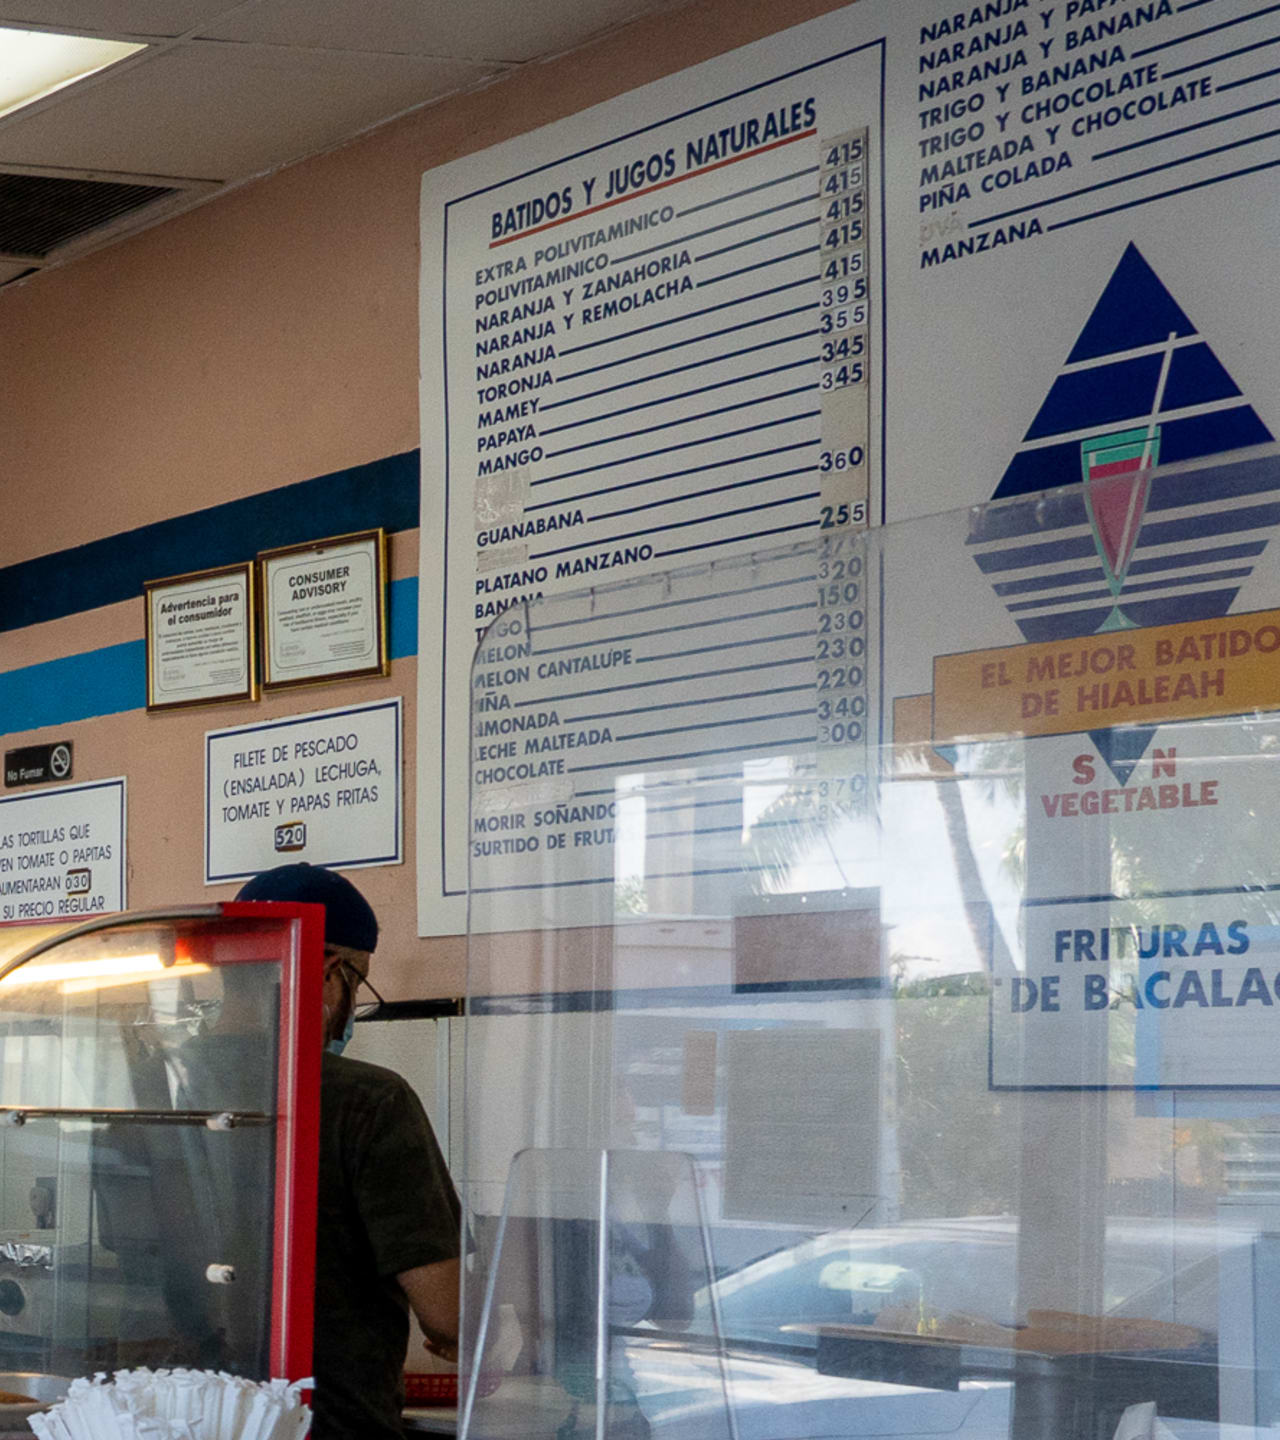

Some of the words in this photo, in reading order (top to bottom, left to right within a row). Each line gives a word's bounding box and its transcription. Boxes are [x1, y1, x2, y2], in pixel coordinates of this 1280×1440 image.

[918, 20, 1028, 74] NARANJA
[1039, 10, 1055, 30] Y
[918, 50, 1028, 103] NARANJA
[1039, 39, 1054, 60] Y
[1065, 0, 1174, 51] BANANA
[918, 121, 985, 158] TRIGO
[995, 111, 1010, 133] Y
[1021, 62, 1160, 125] CHOCOLATE
[919, 93, 985, 131] TRIGO
[995, 82, 1010, 103] Y
[1020, 45, 1126, 97] BANANA
[919, 135, 1035, 187] MALTEADA
[1045, 125, 1061, 146] Y
[1070, 76, 1214, 139] CHOCOLATE
[491, 187, 573, 240] BATIDOS
[582, 179, 598, 201] Y
[605, 147, 677, 200] JUGOS
[685, 97, 818, 170] NATURALES
[919, 181, 972, 214] PIÑA
[981, 150, 1074, 194] COLADA
[475, 254, 528, 286] EXTRA
[534, 205, 676, 268] POLIVITAMINICO
[825, 138, 864, 169] 415
[475, 252, 610, 310] POLIVITAMINICO
[824, 166, 863, 196] 415
[920, 217, 1043, 270] MANZANA
[475, 294, 556, 334] NARANJA
[562, 288, 575, 308] Y
[581, 249, 692, 301] ZANAHORIA
[825, 194, 864, 222] 415
[475, 320, 557, 359] NARANJA
[563, 312, 576, 332] Y
[581, 274, 694, 327] REMOLACHA
[825, 220, 864, 250] 415
[476, 344, 557, 382] NARANJA
[824, 252, 863, 283] 415
[477, 370, 554, 406] TORONJA
[822, 279, 867, 308] 395
[477, 397, 540, 430] MAMEY
[820, 306, 866, 334] 355
[477, 423, 537, 454] PAPAYA
[821, 334, 865, 363] 345
[478, 446, 544, 477] MANGO
[821, 363, 864, 391] 345
[476, 509, 585, 548] GUANABANA
[819, 446, 864, 473] 360
[475, 567, 548, 595] PLATANO
[555, 543, 654, 581] MANZANO
[819, 503, 865, 530] 255
[819, 556, 862, 581] 320
[288, 565, 350, 588] CONSUMER
[291, 580, 348, 602] ADVISORY
[817, 582, 859, 607] 150
[160, 597, 217, 615] Advertencia
[218, 592, 240, 606] para
[167, 613, 177, 627] el
[178, 606, 233, 626] consumidor
[537, 648, 633, 679] CANTALUPE
[819, 609, 864, 634] 230
[817, 636, 864, 660] 230
[980, 661, 1012, 690] EL
[1026, 643, 1137, 684] MEJOR
[817, 666, 862, 692] 220
[1020, 692, 1060, 719] DE
[1076, 669, 1226, 713] HIALEAH
[524, 728, 613, 755] MALTEADA
[817, 695, 865, 720] 340
[7, 770, 18, 782] No
[20, 767, 44, 780] Fumar
[233, 749, 267, 769] FILETE
[272, 745, 289, 764] DE
[294, 733, 358, 760] PESCADO
[475, 759, 565, 785] CHOCOLATE
[819, 721, 862, 744] 300
[222, 801, 270, 824] TOMATE
[276, 799, 285, 816] Y
[290, 793, 331, 815] PAPAS
[336, 785, 379, 808] FRITAS
[223, 768, 305, 798] (ENSALADA)
[1040, 779, 1220, 820] VEGETABLE
[17, 827, 65, 848] TORTILLAS
[69, 823, 91, 841] QUE
[275, 827, 304, 846] 520
[473, 836, 540, 858] SURTIDO
[547, 833, 566, 850] DE
[474, 813, 526, 834] MORIR
[17, 851, 56, 871] TOMATE
[59, 850, 69, 866] O
[73, 845, 112, 863] PAPITAS
[65, 873, 89, 891] 030
[3, 904, 15, 920] SU
[18, 900, 55, 919] PRECIO
[58, 895, 106, 914] REGULAR
[1054, 920, 1251, 963] FRITURAS
[1010, 975, 1061, 1014] DE
